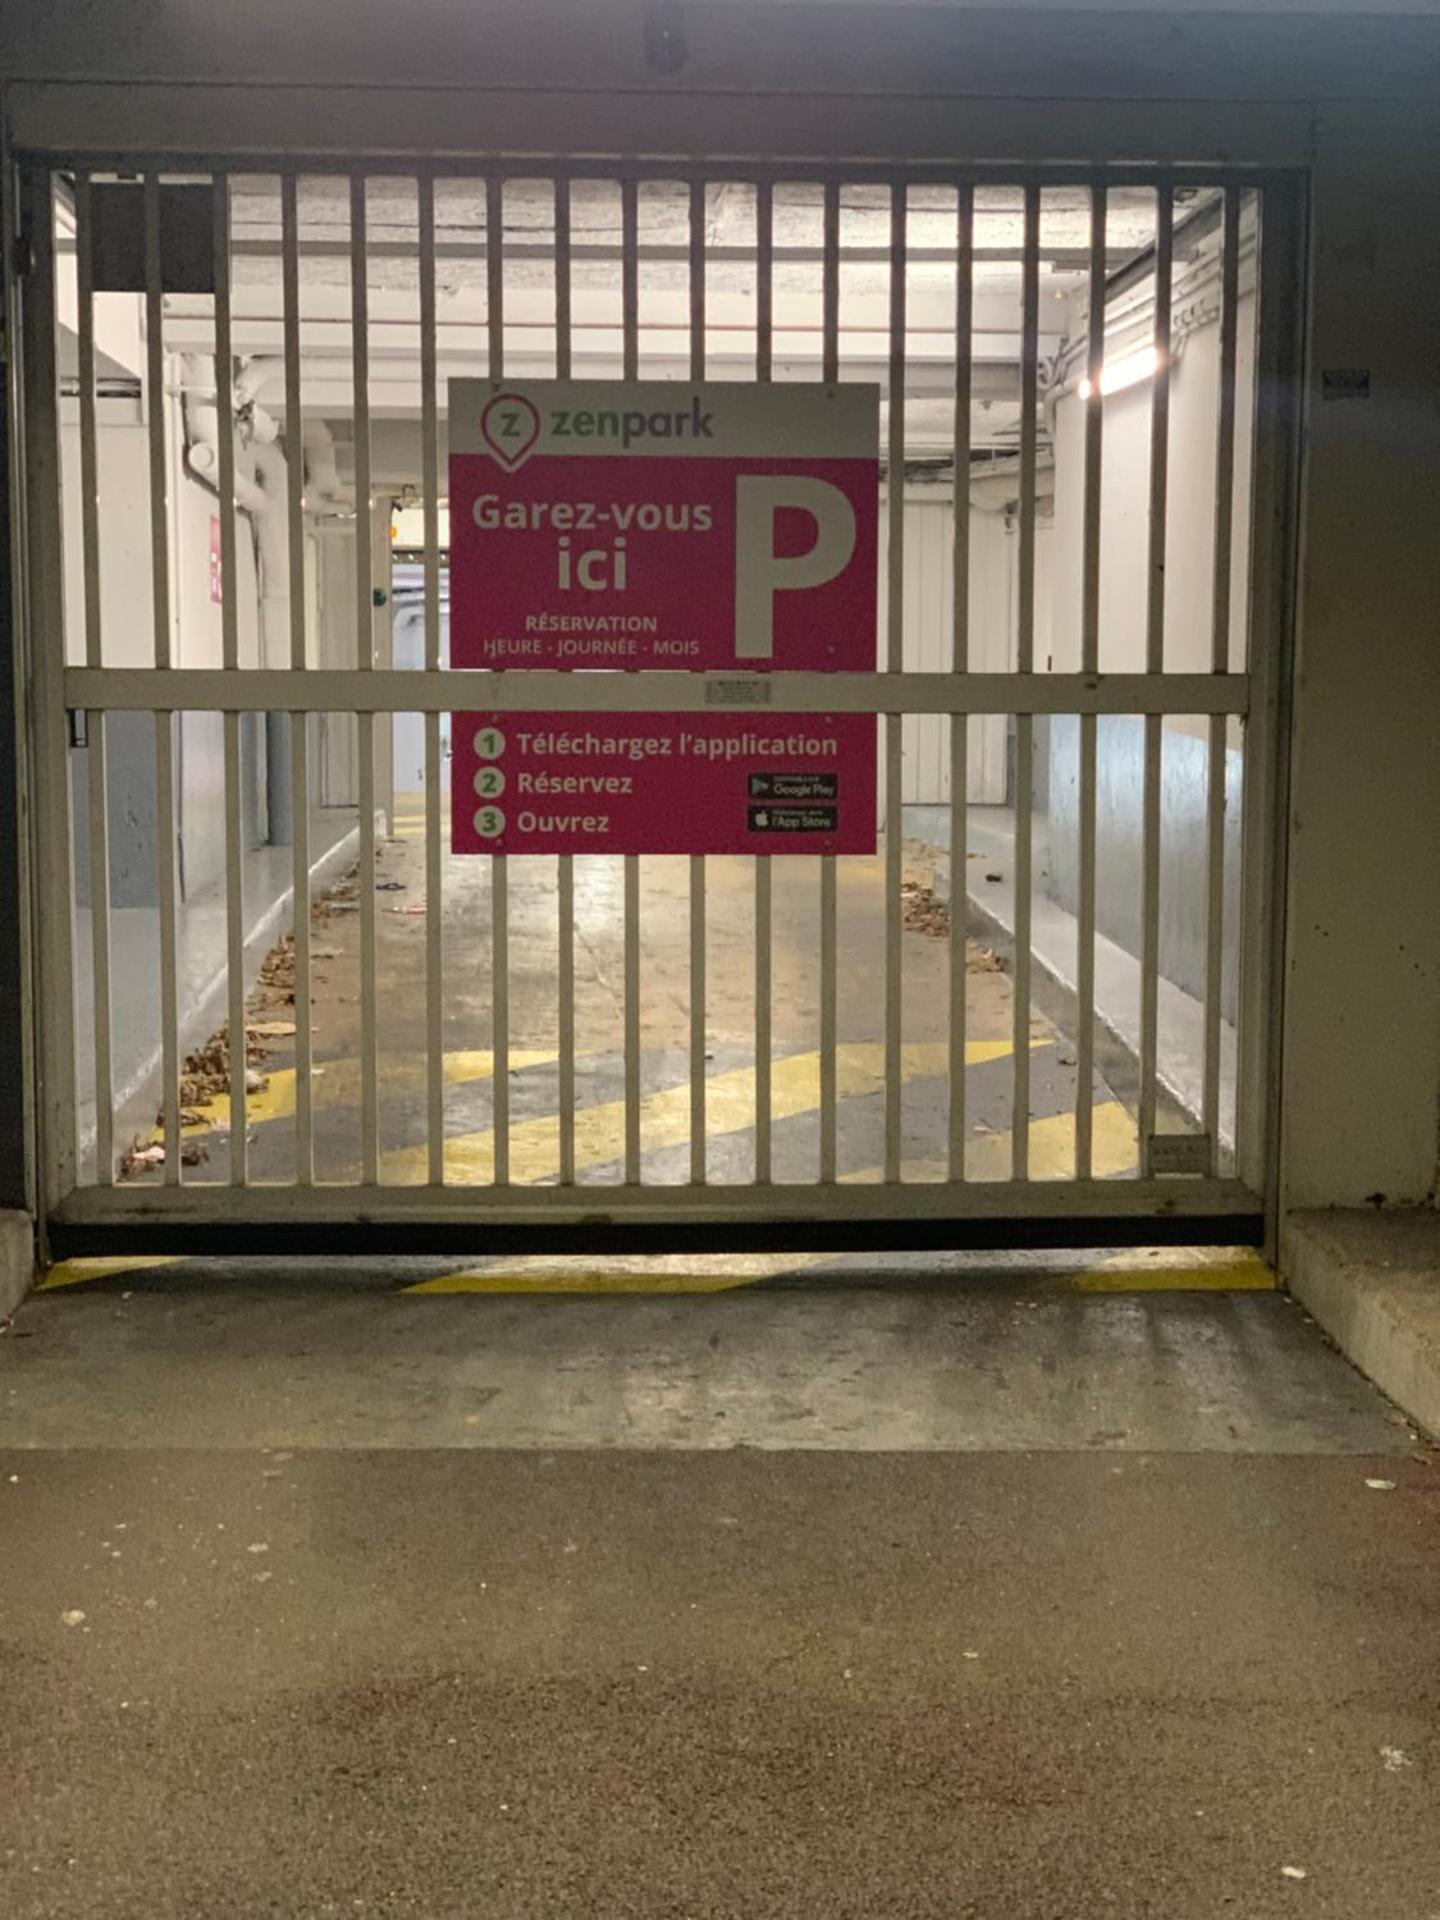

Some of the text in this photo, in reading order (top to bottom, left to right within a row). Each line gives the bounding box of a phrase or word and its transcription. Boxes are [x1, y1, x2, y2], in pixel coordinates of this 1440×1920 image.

[550, 396, 714, 448] zenpark
[472, 495, 713, 531] Garez-vous
[557, 536, 628, 591] ici
[735, 474, 857, 659] P
[525, 611, 657, 632] RÉSERVATION
[484, 639, 542, 656] HEURE
[556, 635, 636, 658] JOURNÉE
[654, 640, 699, 656] MOIS
[516, 733, 671, 759] Téléchargez
[517, 770, 633, 794] Réservez
[773, 783, 834, 796] Google Play
[516, 812, 610, 833] Ouvrez
[801, 816, 831, 827] Store
